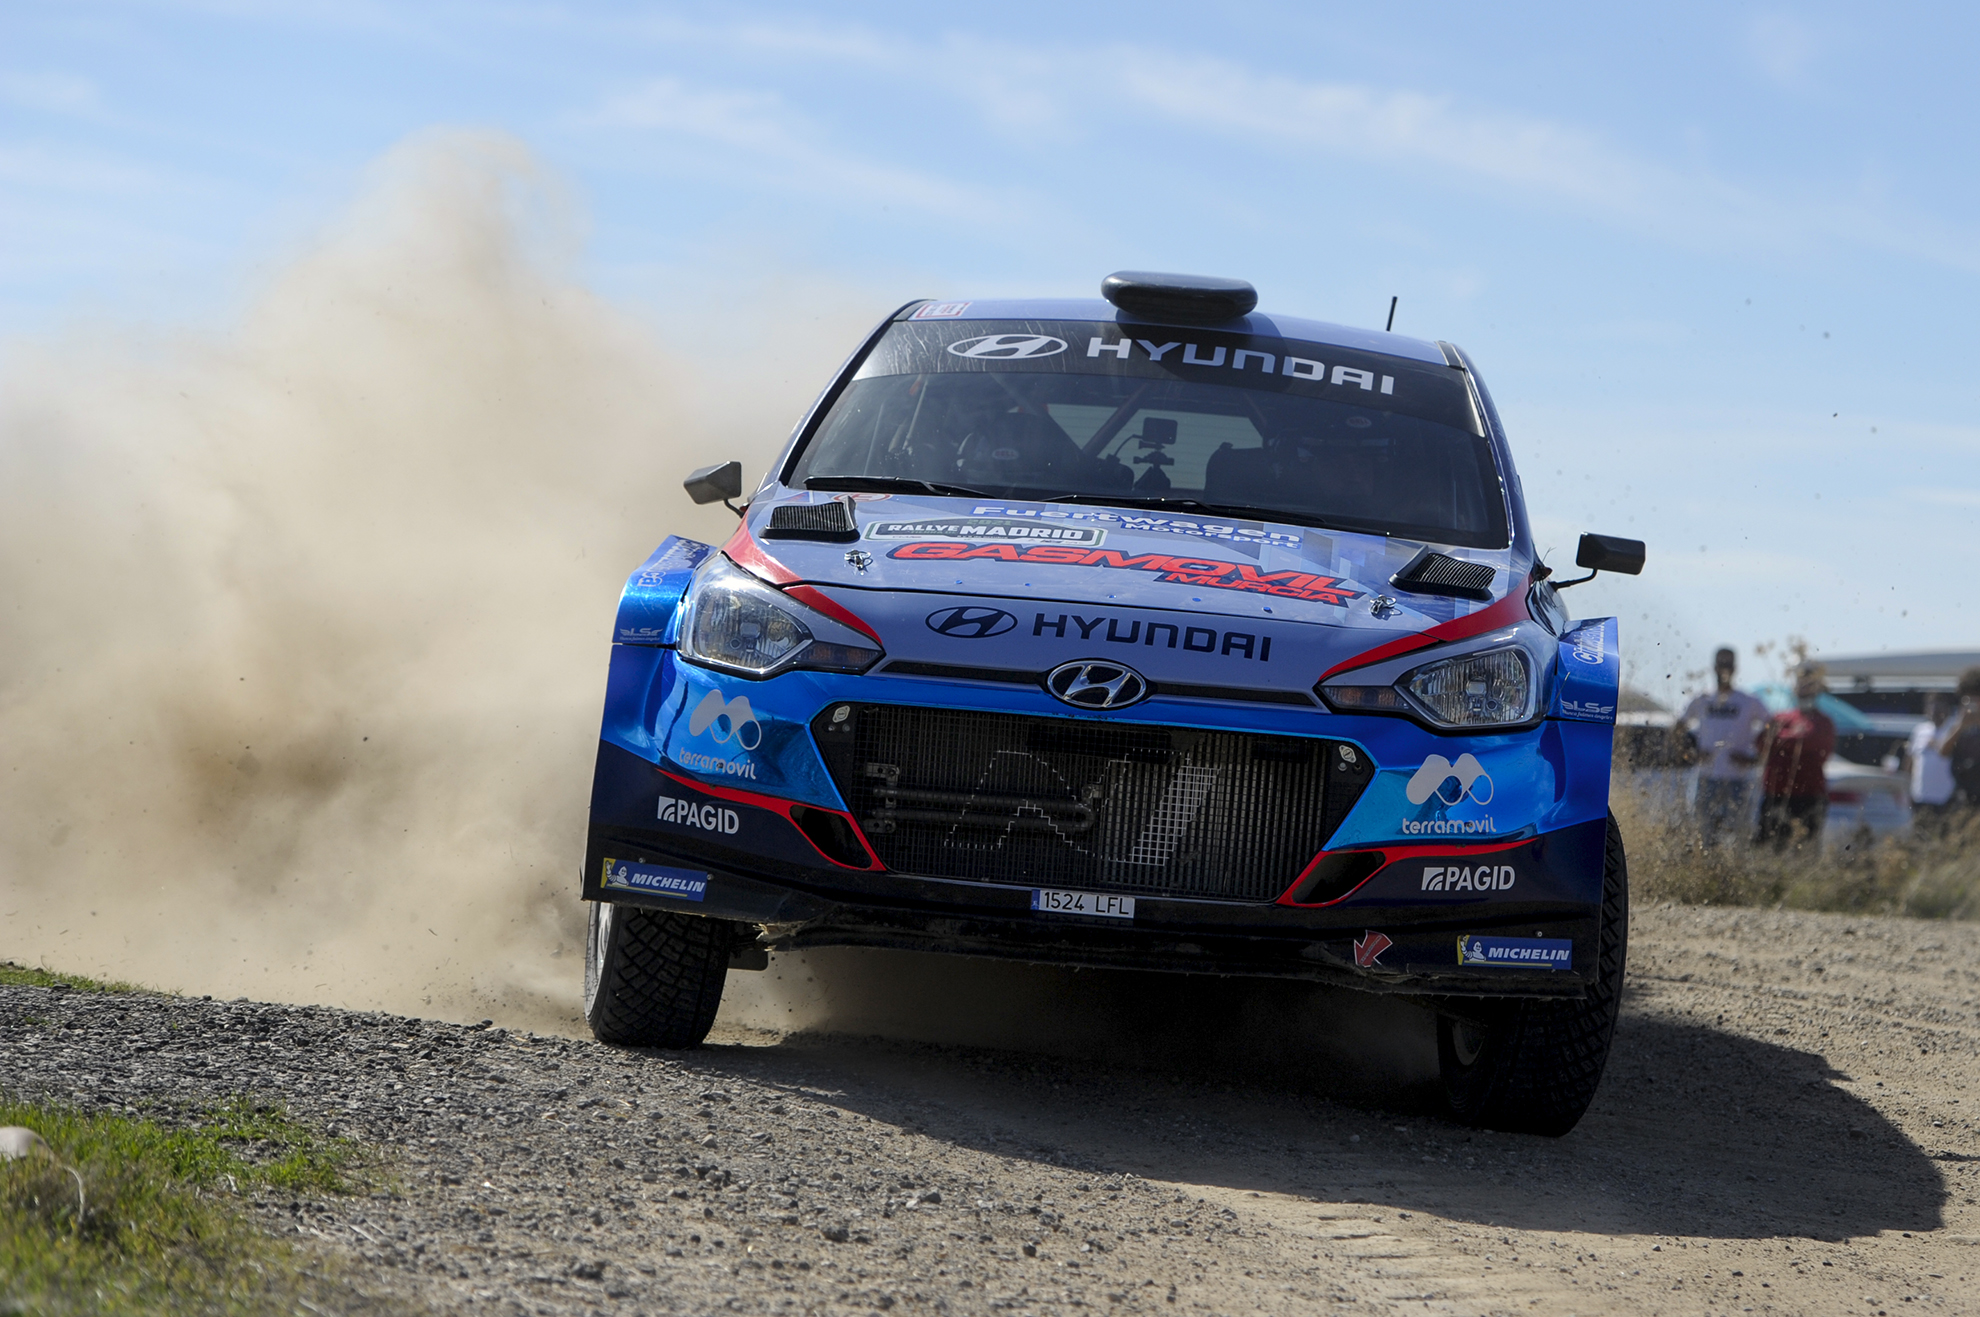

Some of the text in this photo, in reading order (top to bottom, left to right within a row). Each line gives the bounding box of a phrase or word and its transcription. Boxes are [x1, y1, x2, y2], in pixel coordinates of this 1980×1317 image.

[1086, 336, 1395, 395] HYUNDAI
[960, 525, 1084, 539] MADRID
[973, 506, 1302, 542] Fuertwagen
[1123, 522, 1301, 549] Motorsport
[892, 542, 1360, 598] GASMOVIL
[1165, 572, 1340, 605] MURCIA
[1032, 613, 1272, 662] HYUNDAI
[679, 747, 757, 780] terramovil
[677, 799, 740, 834] PAGID
[1402, 814, 1497, 834] terramovil
[631, 872, 706, 892] MICHELIN
[1445, 866, 1515, 890] PAGID
[1044, 891, 1129, 915] 1524 LFL
[1488, 947, 1570, 961] MICHELIN
